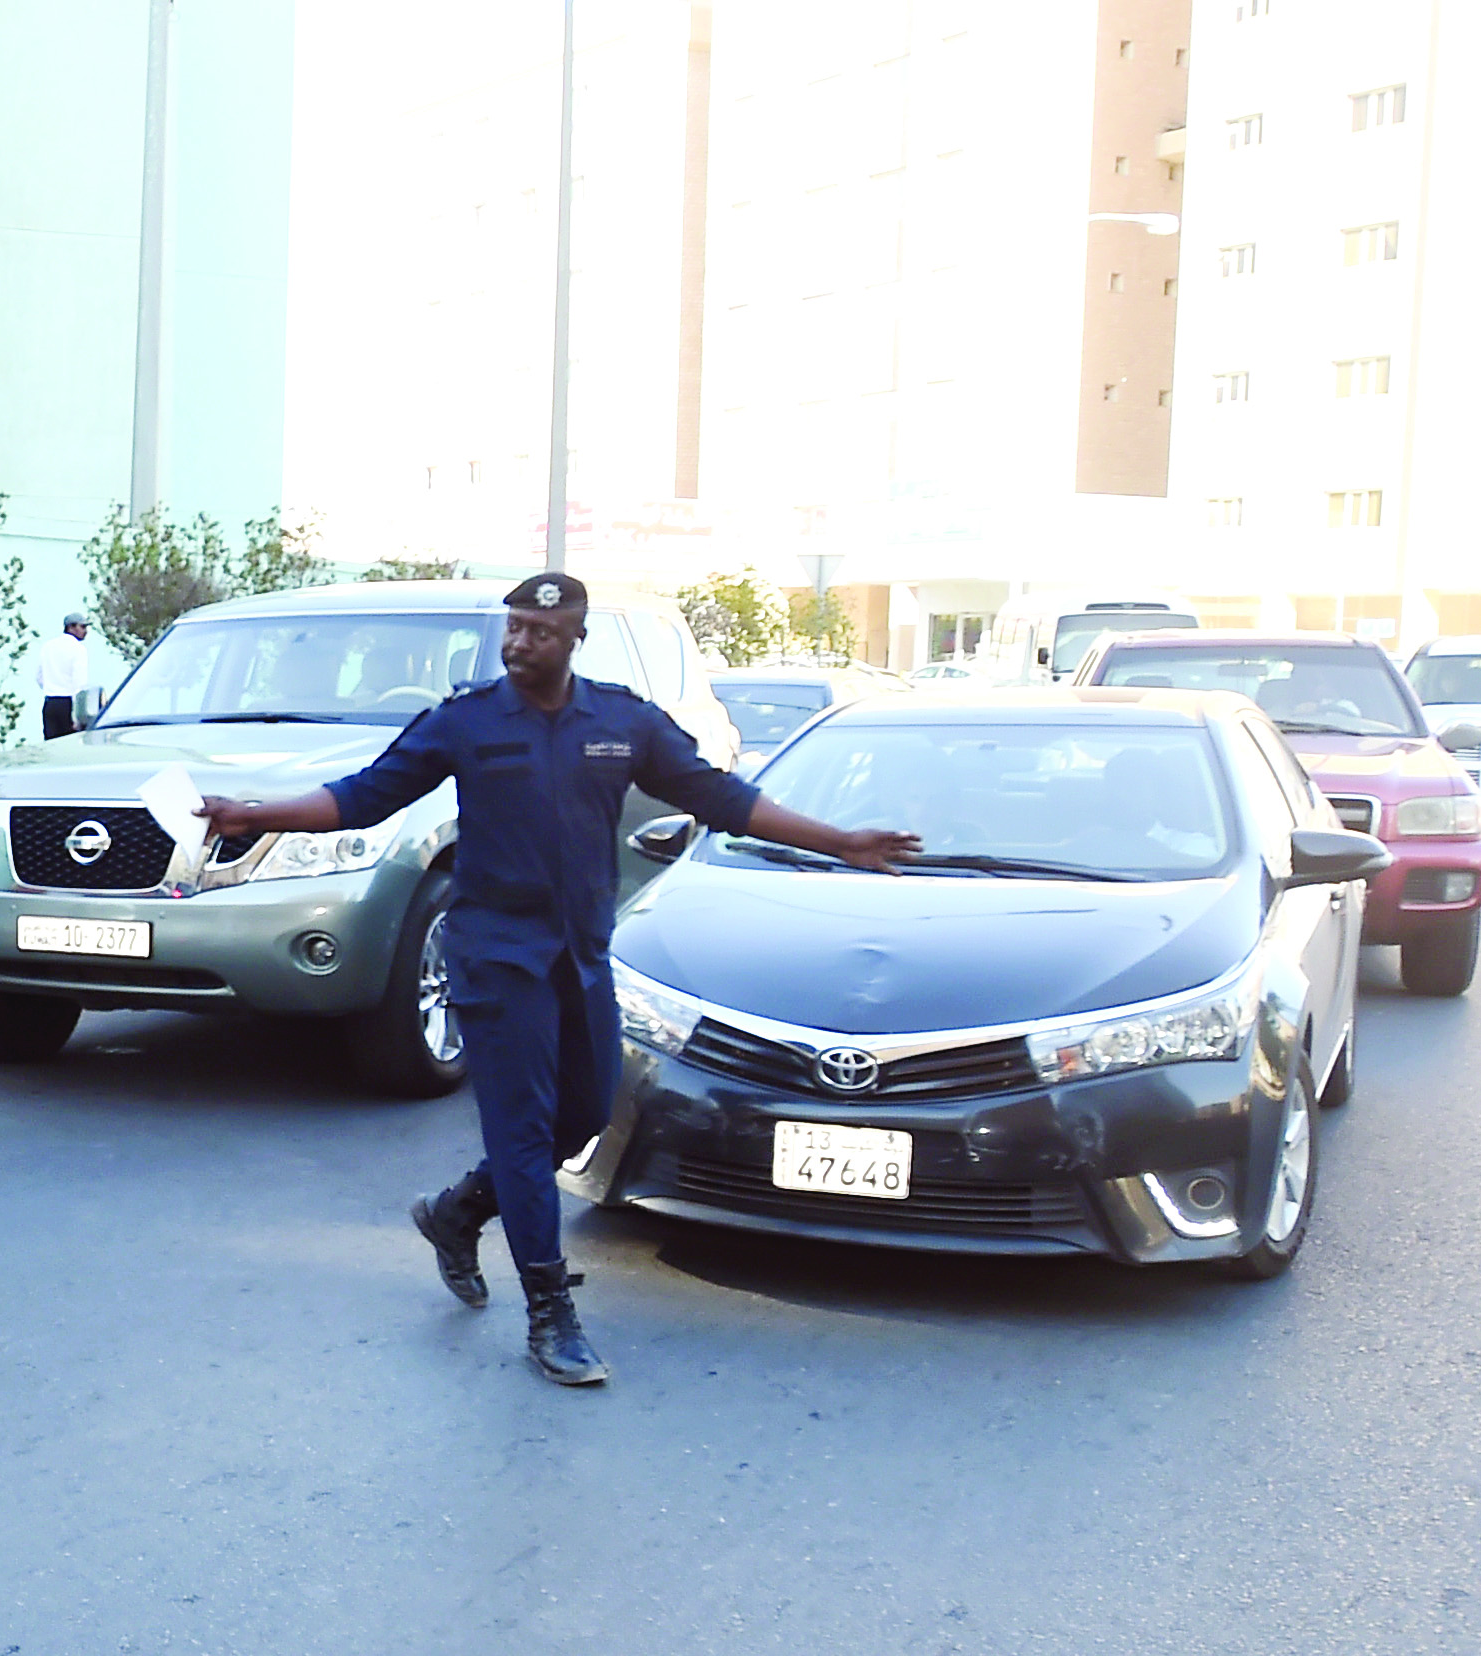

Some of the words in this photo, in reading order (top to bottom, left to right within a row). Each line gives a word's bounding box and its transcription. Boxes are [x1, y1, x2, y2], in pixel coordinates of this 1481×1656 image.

[64, 925, 83, 947] 10
[96, 927, 137, 951] 2377
[805, 1130, 831, 1150] 13
[798, 1156, 900, 1190] 47648
